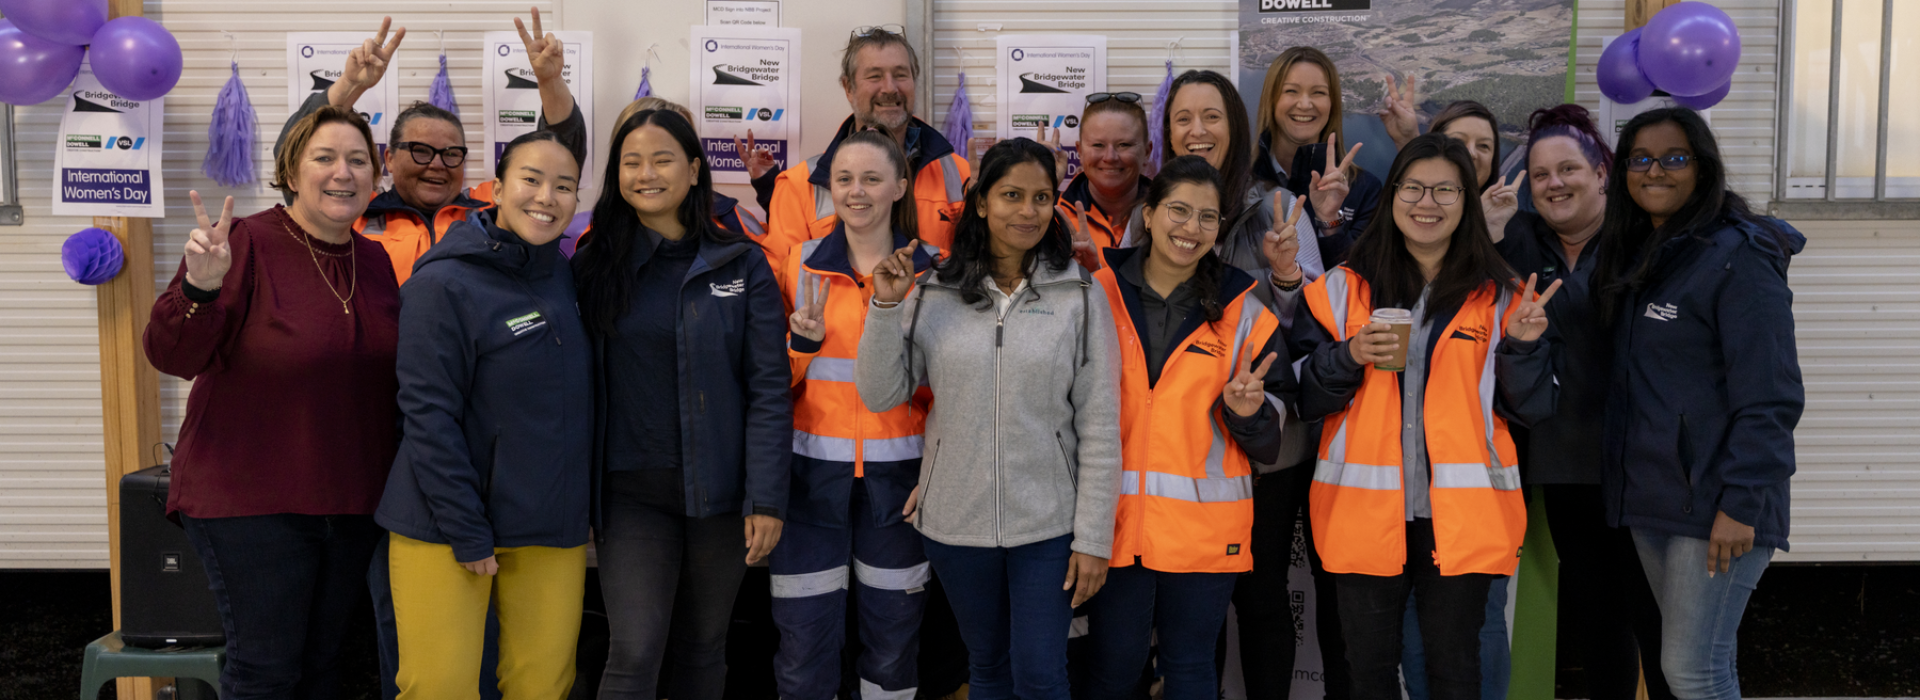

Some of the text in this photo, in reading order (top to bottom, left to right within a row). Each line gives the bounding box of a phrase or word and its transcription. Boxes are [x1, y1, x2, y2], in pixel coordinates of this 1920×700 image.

[1262, 0, 1332, 10] DOWELL
[728, 65, 779, 74] Bridgewater
[752, 73, 779, 82] Bridge
[1034, 73, 1085, 81] Bridgewater
[1058, 81, 1085, 89] Bridge
[110, 100, 140, 109] Bridge
[67, 170, 143, 184] International
[64, 186, 148, 203] Women's Day
